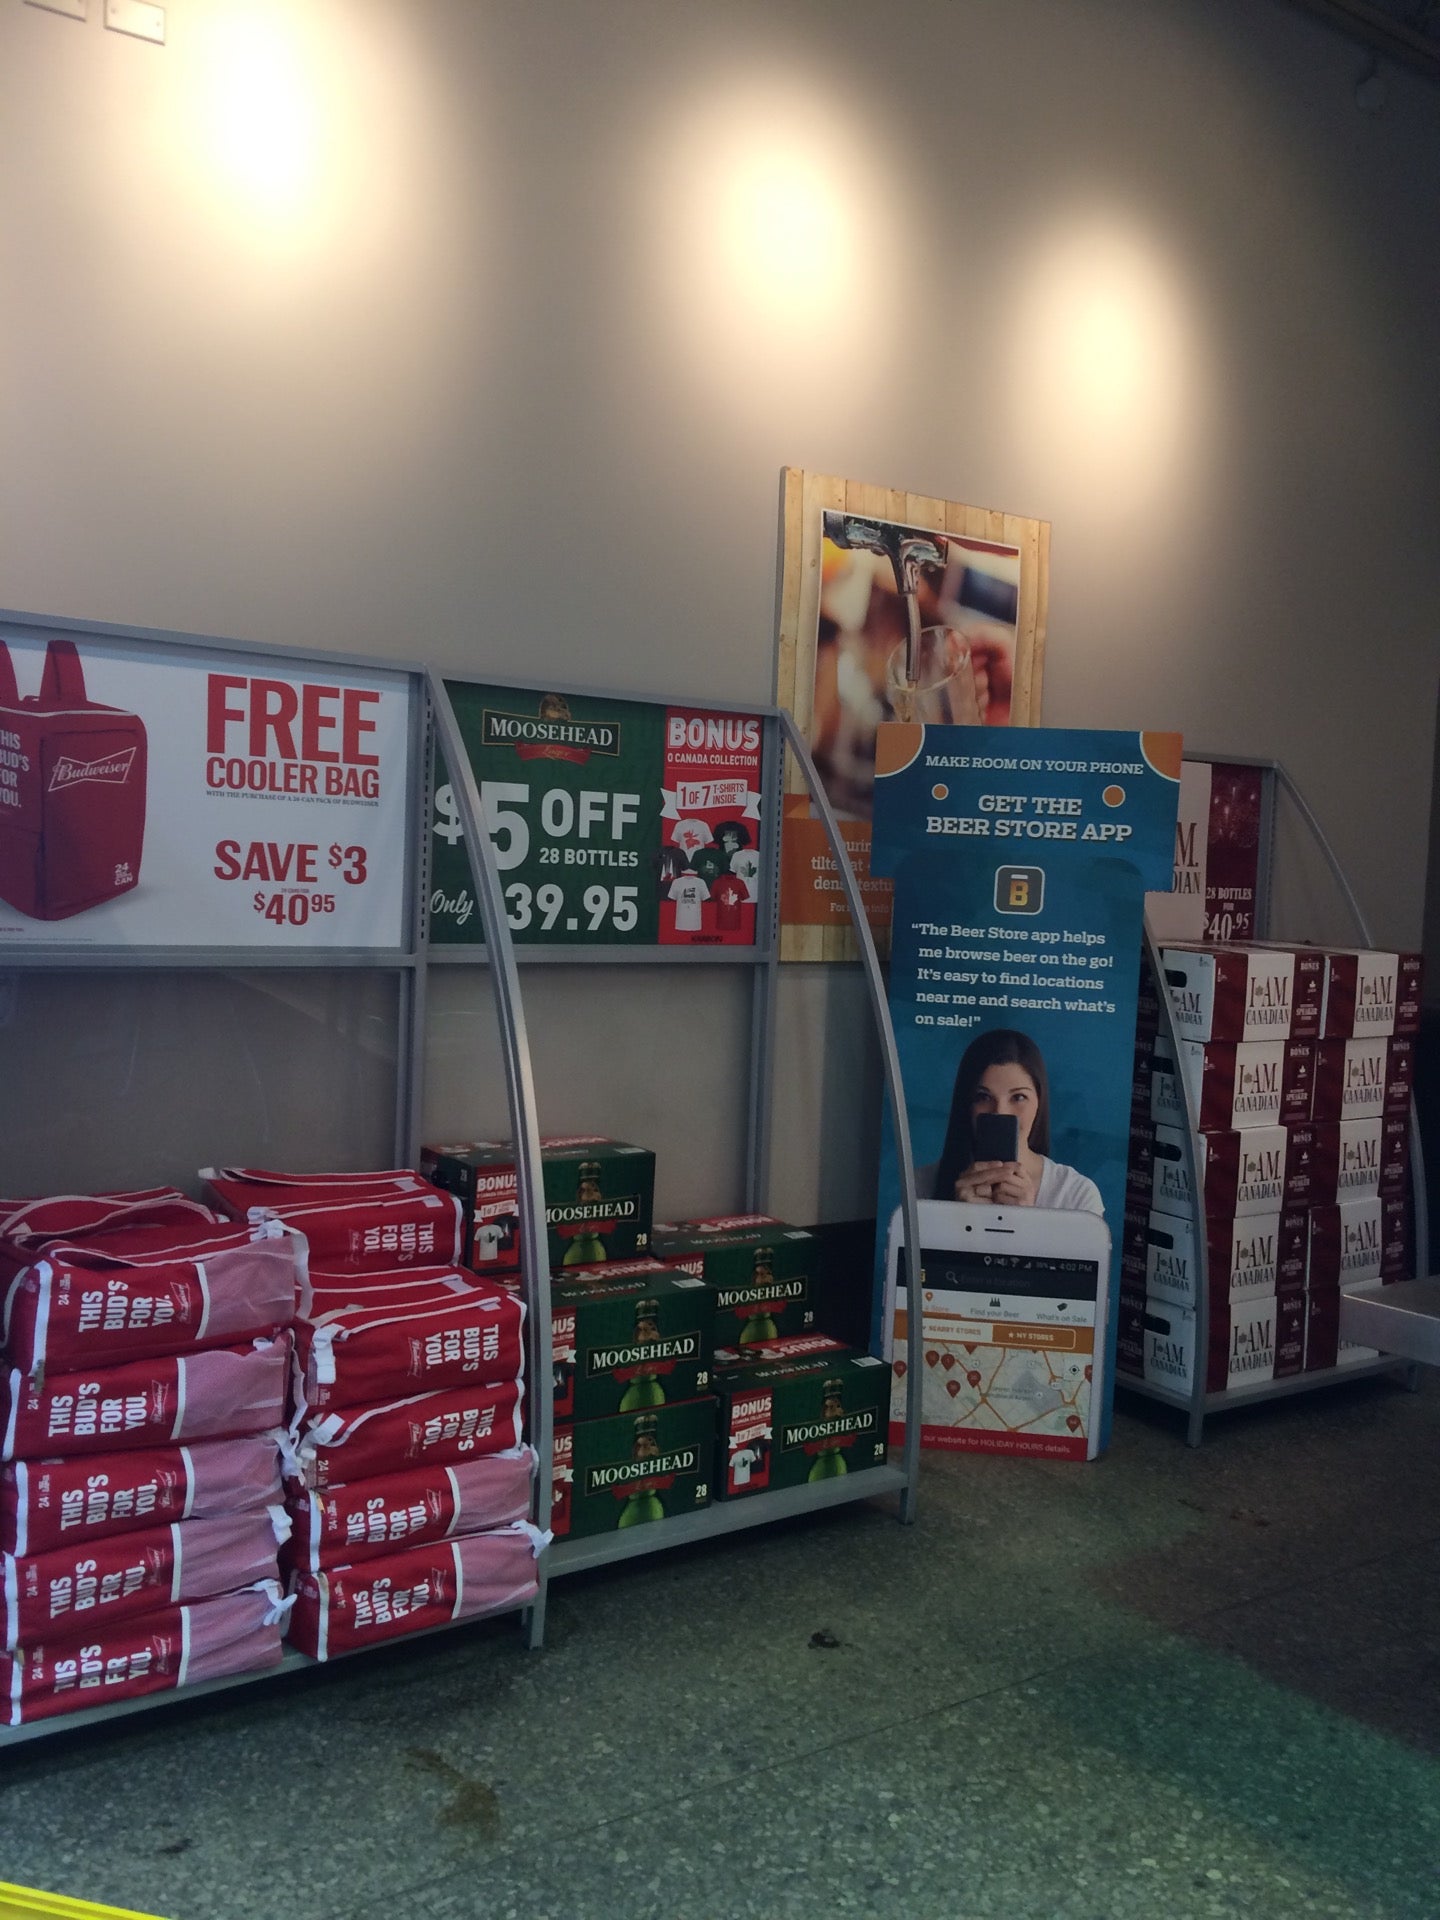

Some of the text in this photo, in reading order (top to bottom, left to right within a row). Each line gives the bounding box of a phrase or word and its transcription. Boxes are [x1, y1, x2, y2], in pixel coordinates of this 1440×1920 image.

[207, 673, 380, 766] FREE
[0, 729, 20, 750] HIS
[490, 717, 614, 747] MOOSEHEAD
[667, 716, 760, 753] BONUS
[675, 753, 709, 765] CANADA
[709, 754, 758, 767] COLLECTION
[925, 755, 1144, 775] MAKE ROOM ON YOUR PHONE
[0, 769, 17, 788] OR
[52, 762, 129, 782] Budweiser
[206, 756, 379, 799] COOLER BAG
[681, 785, 711, 807] 1 OF 7
[713, 783, 745, 794] T-SHIRTS
[713, 794, 737, 805] INSIDE
[541, 787, 641, 840] OFF
[978, 794, 1083, 816] GET THE
[926, 816, 1133, 842] BEER STORE APP
[115, 862, 129, 873] 24
[214, 840, 367, 885] SAVE $3
[539, 848, 639, 868] 28 BOTTLES
[1206, 886, 1252, 901] 28 BOTTLES
[430, 888, 474, 926] Only
[950, 924, 985, 939] Beer
[987, 926, 1029, 941] Store
[1031, 930, 1060, 945] app
[1062, 930, 1106, 946] helps
[918, 947, 1114, 970] me browse beer on the go!
[943, 971, 979, 986] easy
[981, 971, 997, 983] to
[999, 971, 1030, 985] find
[1032, 973, 1105, 990] locations
[1250, 977, 1256, 1007] I
[1359, 977, 1365, 1005] I
[916, 991, 1116, 1013] near me and search what's
[915, 1014, 935, 1026] on
[1246, 1009, 1289, 1025] CANADIAN
[1356, 1006, 1393, 1022] CANADIAN
[1238, 1065, 1245, 1094] I
[1234, 1095, 1279, 1112] CANADIAN
[382, 1225, 398, 1252] FOR
[418, 1222, 434, 1254] THIS
[636, 1233, 648, 1246] 28
[1077, 1263, 1093, 1273] PM
[717, 1281, 803, 1307] MOOSEHEAD
[78, 1290, 104, 1333] THIS
[128, 1296, 154, 1329] FOR
[804, 1311, 814, 1324] 28
[1071, 1315, 1088, 1323] Sale
[443, 1329, 461, 1362] FOR
[482, 1323, 499, 1362] THIS
[1028, 1333, 1054, 1341] STORES
[592, 1337, 695, 1370] MOOSEHEAD
[697, 1371, 708, 1386] 28
[48, 1394, 74, 1437] THIS
[100, 1398, 123, 1434] FOR
[732, 1396, 772, 1419] BONUS
[786, 1412, 873, 1445] MOOSEHEAD
[874, 1443, 884, 1456] 28
[937, 1437, 967, 1445] website
[967, 1438, 980, 1446] for
[980, 1439, 1014, 1449] HOLIDAY
[1015, 1442, 1044, 1451] HOURS
[591, 1451, 694, 1488] MOOSEHEAD
[696, 1484, 707, 1498] 28
[60, 1488, 84, 1531] THIS
[111, 1488, 135, 1519] FOR
[50, 1576, 72, 1620] THIS
[99, 1570, 123, 1604] FOR
[353, 1590, 373, 1629] THIS
[393, 1588, 412, 1619] FOR
